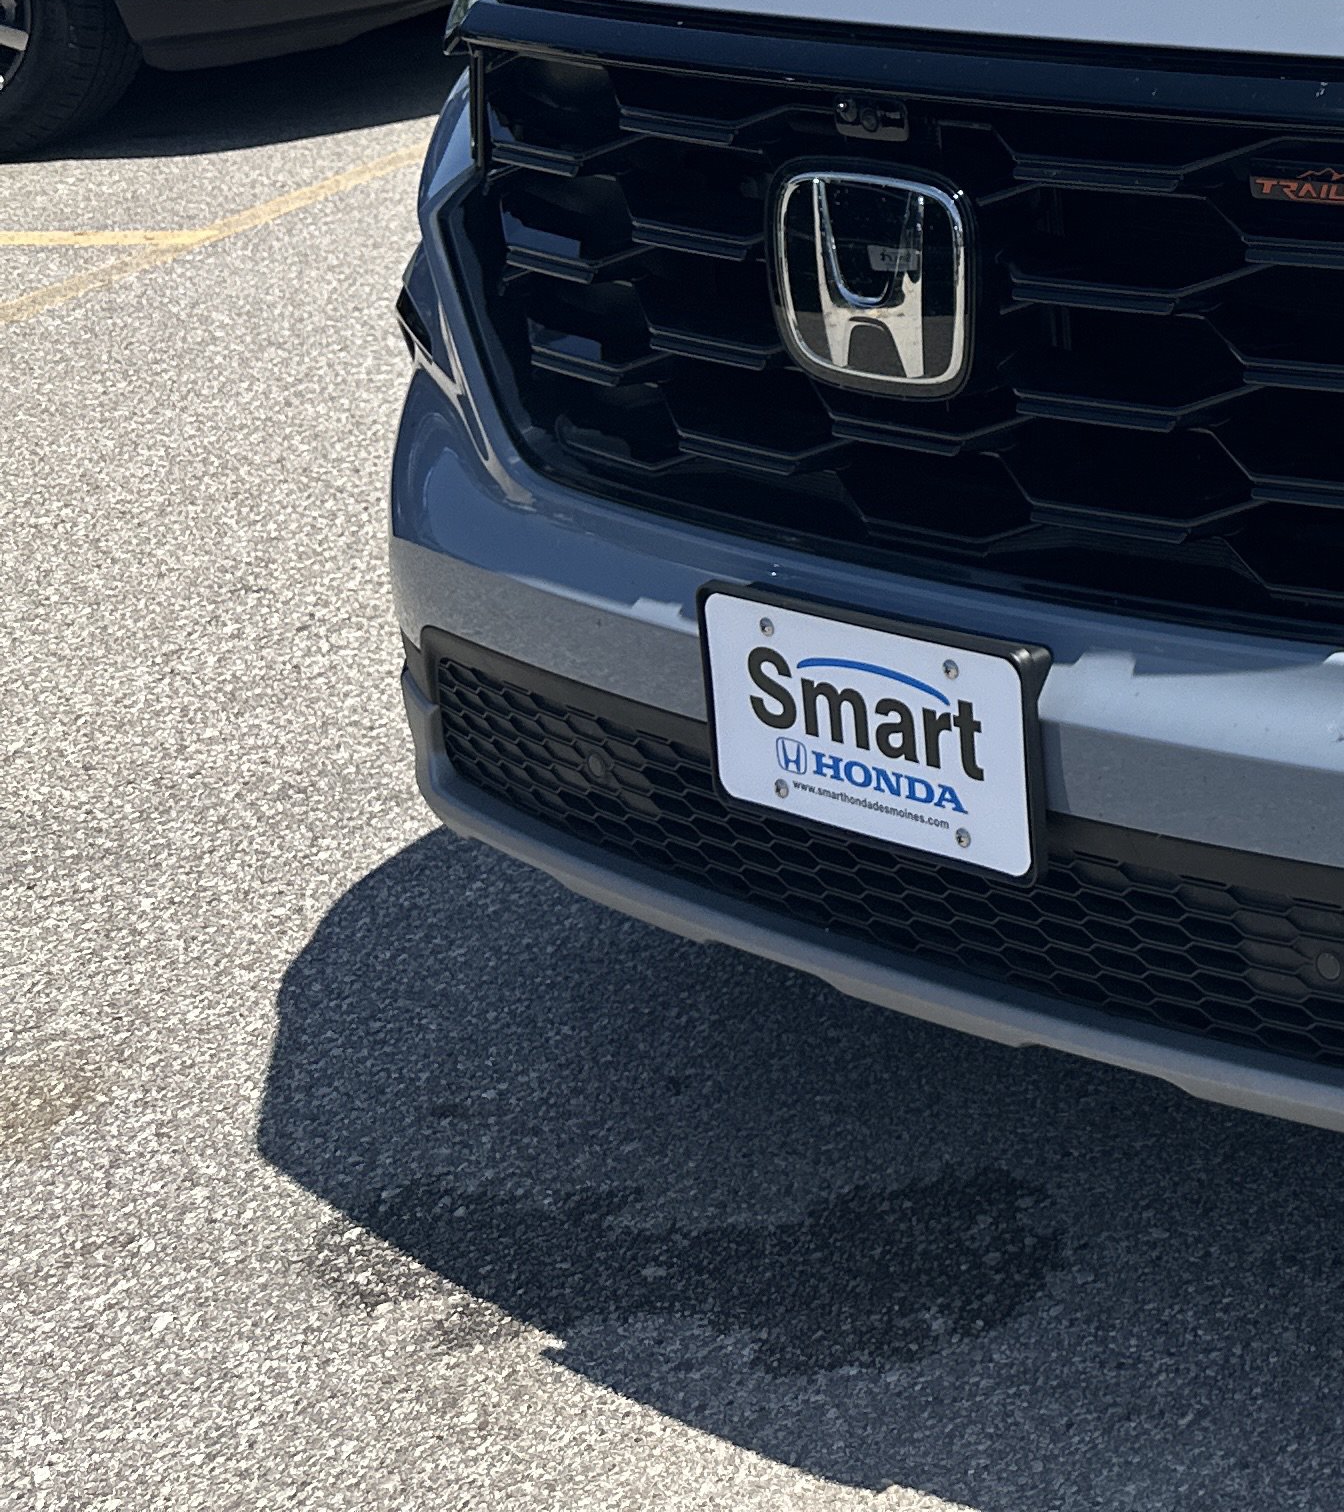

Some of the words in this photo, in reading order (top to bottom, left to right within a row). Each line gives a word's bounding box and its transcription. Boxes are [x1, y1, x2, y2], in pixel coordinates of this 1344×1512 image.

[747, 646, 985, 782] Smart
[792, 779, 951, 830] www.smarthondadesmoines.com
[811, 750, 969, 815] HONDA
